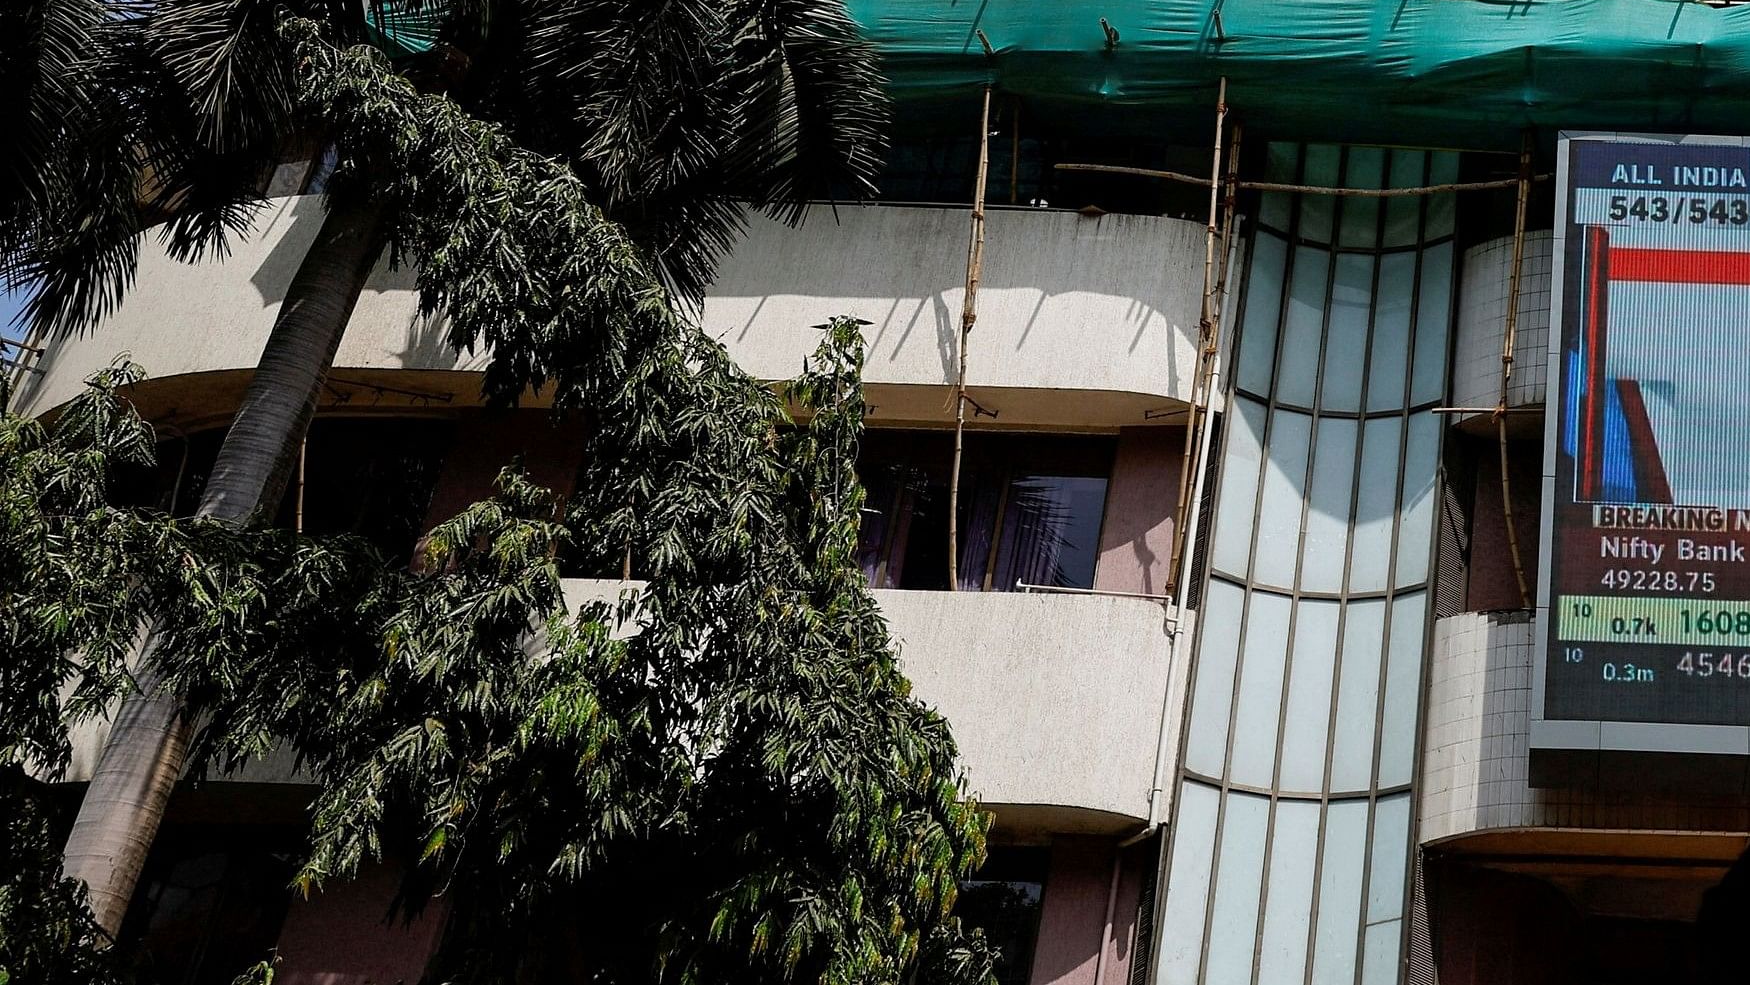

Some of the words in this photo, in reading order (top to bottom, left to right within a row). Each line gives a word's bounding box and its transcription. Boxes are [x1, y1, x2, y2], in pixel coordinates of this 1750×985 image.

[1611, 163, 1662, 187] ALL
[1673, 166, 1748, 189] INDIA
[1609, 196, 1750, 226] 543/543
[1598, 506, 1727, 532] BREAKING
[1600, 535, 1665, 565] Nifty
[1677, 538, 1746, 564] Bank
[1600, 568, 1718, 594] 49228.75
[1572, 602, 1593, 619] 10
[1611, 615, 1658, 637] 0.7k
[1602, 662, 1656, 683] 0.3m
